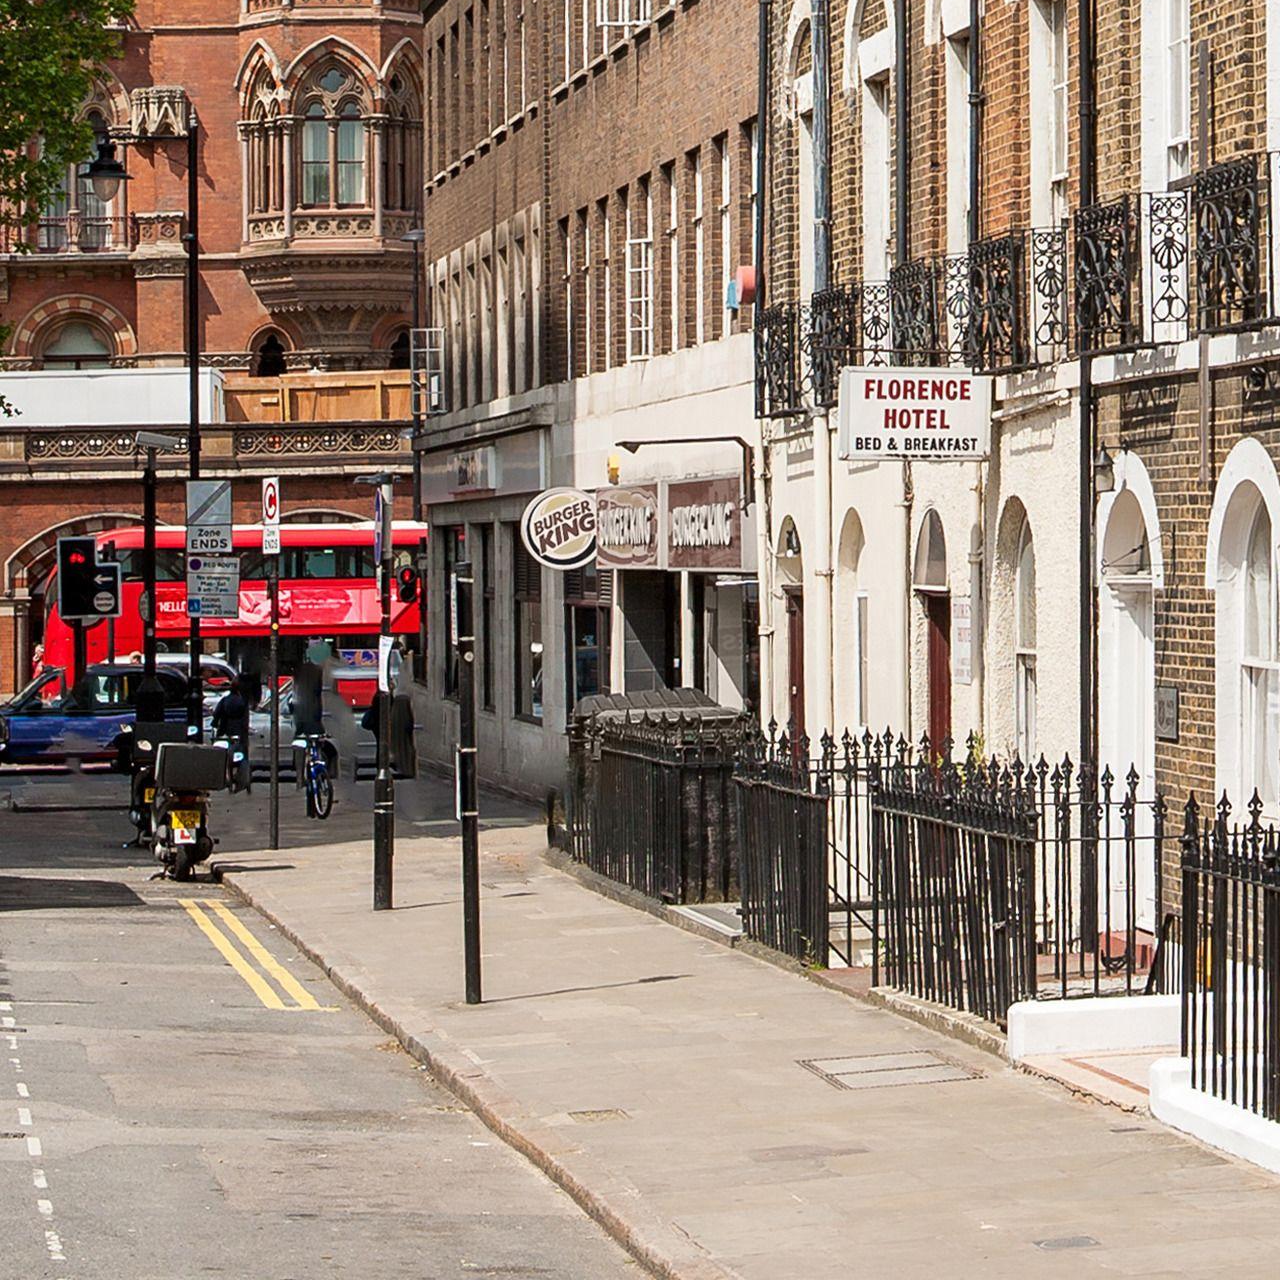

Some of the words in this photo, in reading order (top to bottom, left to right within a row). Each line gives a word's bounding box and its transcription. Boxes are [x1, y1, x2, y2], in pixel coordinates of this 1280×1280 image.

[864, 379, 972, 401] FLORENCE
[884, 408, 950, 430] HOTEL
[855, 437, 882, 451] BED
[887, 437, 898, 450] &
[904, 438, 979, 452] BREAKFAST
[534, 500, 592, 536] BURGER
[198, 528, 222, 537] Zone
[539, 512, 595, 554] KING
[191, 539, 228, 549] ENDS
